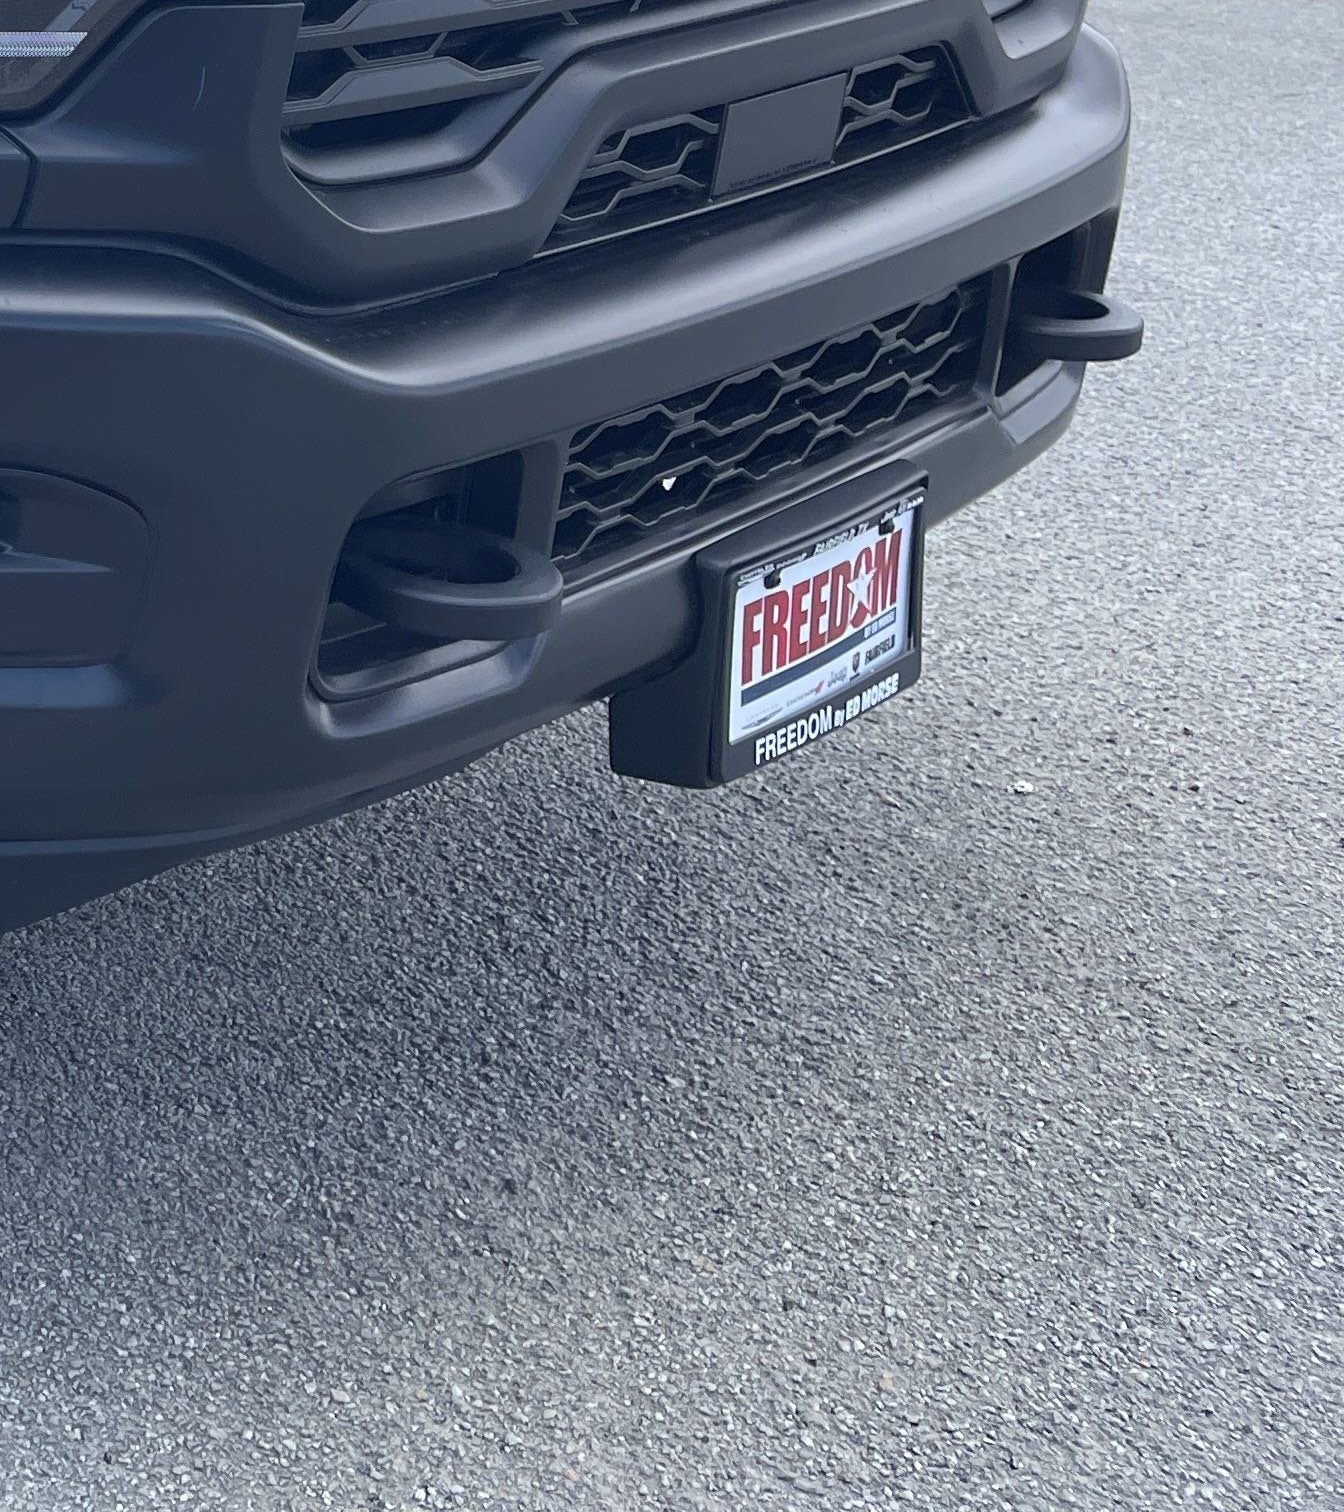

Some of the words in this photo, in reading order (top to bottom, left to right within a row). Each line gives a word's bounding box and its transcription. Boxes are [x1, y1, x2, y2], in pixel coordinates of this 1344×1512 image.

[741, 528, 902, 686] FREEDOM
[755, 705, 833, 765] FREEDOM
[846, 695, 861, 721] ED
[861, 673, 900, 712] MORSE
